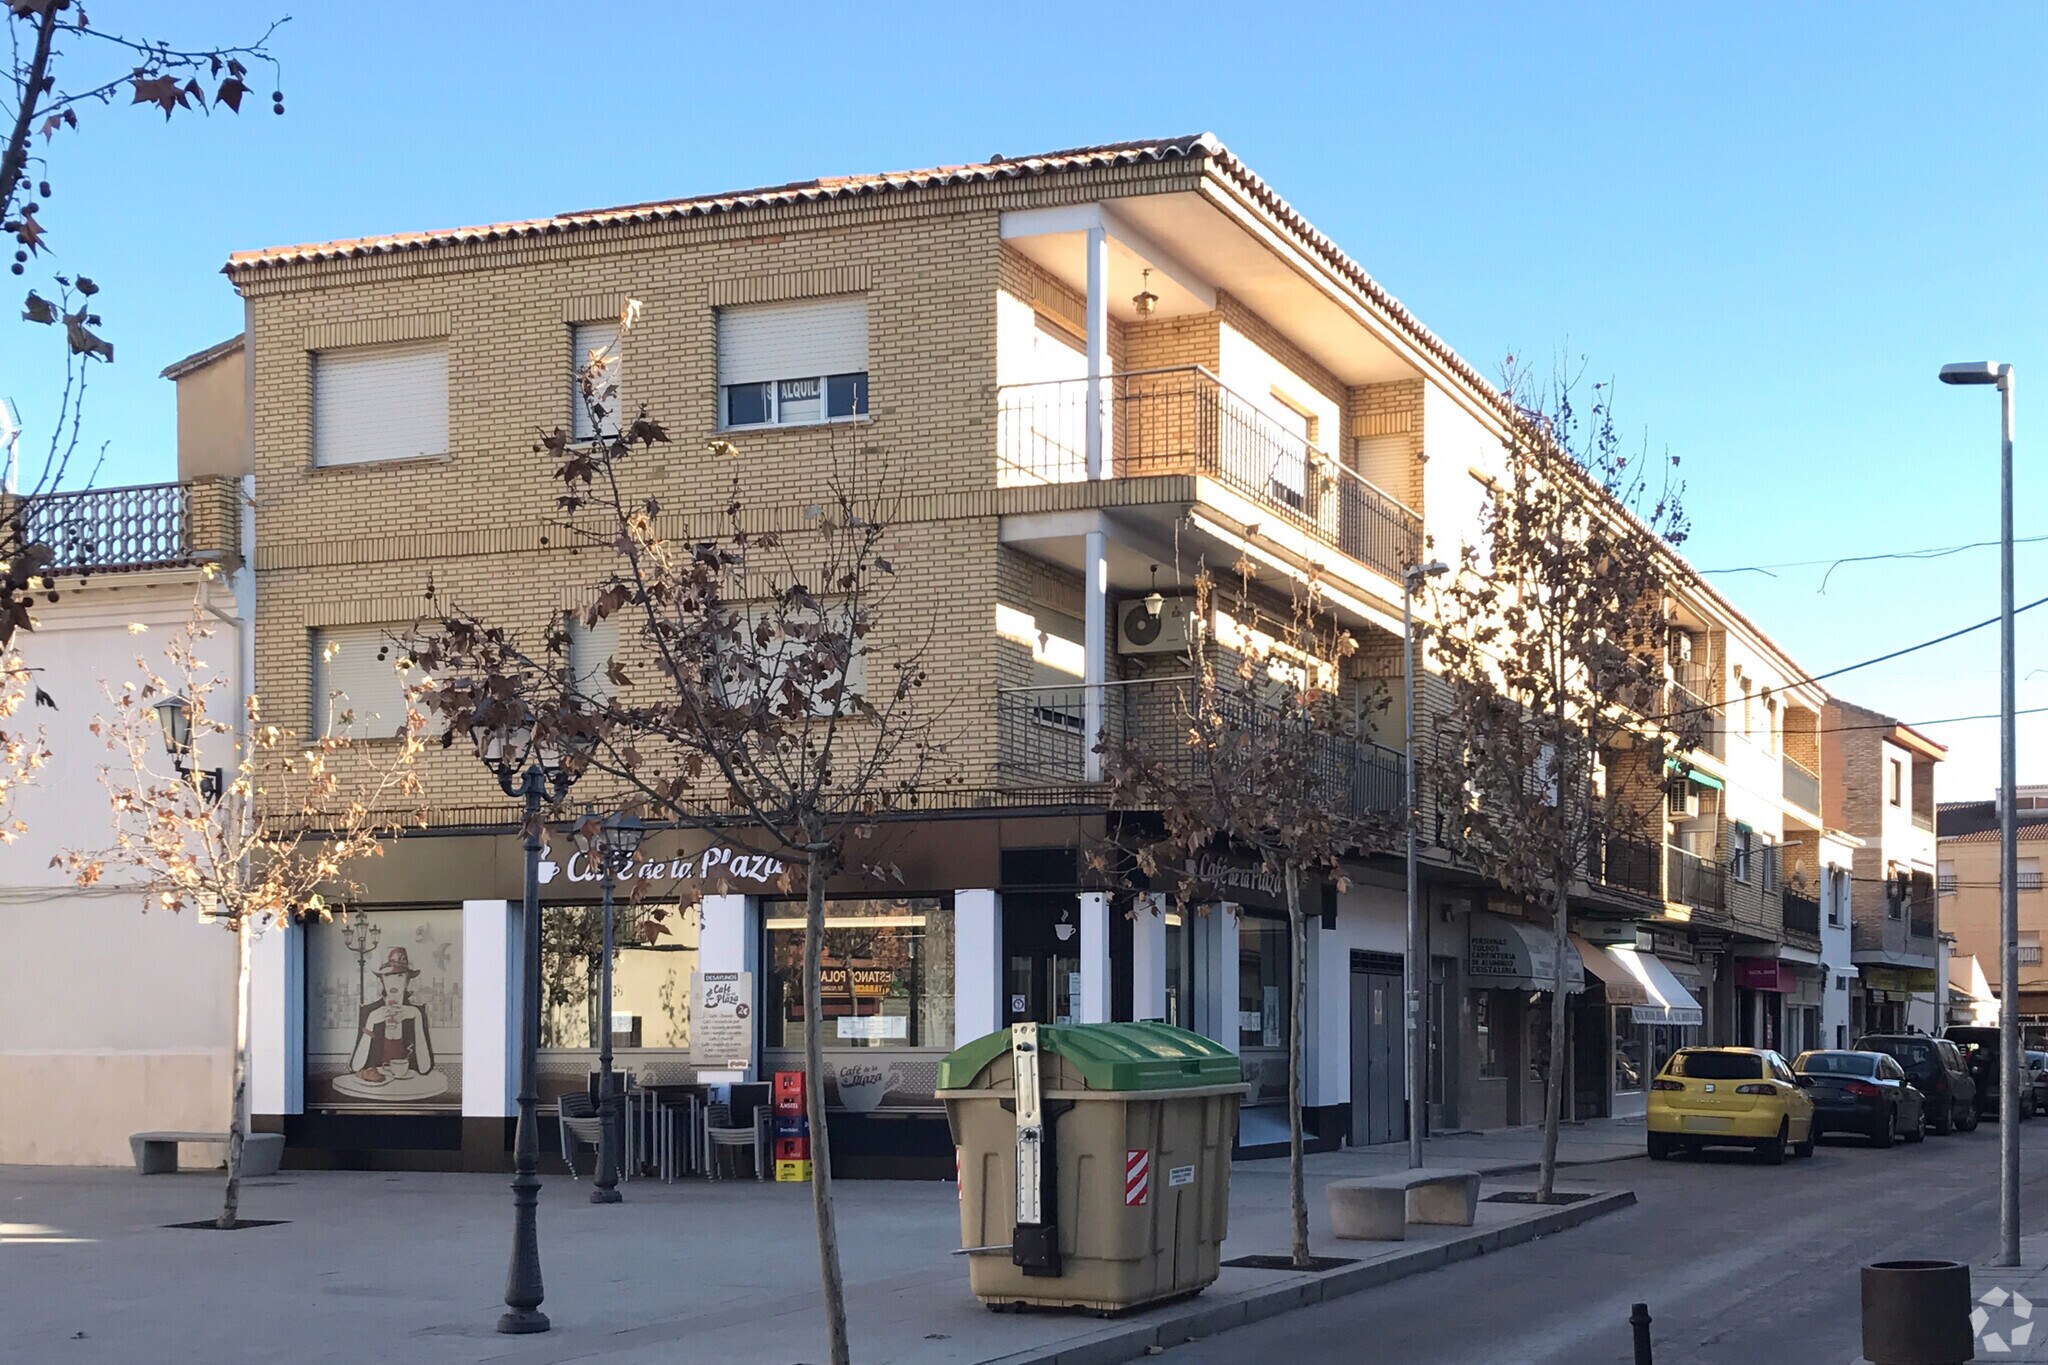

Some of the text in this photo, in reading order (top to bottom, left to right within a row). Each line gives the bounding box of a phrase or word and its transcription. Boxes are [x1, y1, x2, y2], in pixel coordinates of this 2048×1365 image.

[638, 857, 665, 880] de
[670, 857, 692, 880] la
[1199, 852, 1228, 888] Café
[713, 983, 731, 995] Café
[716, 994, 739, 1005] Plaza
[840, 1064, 862, 1078] Café
[852, 1073, 882, 1087] Plaza
